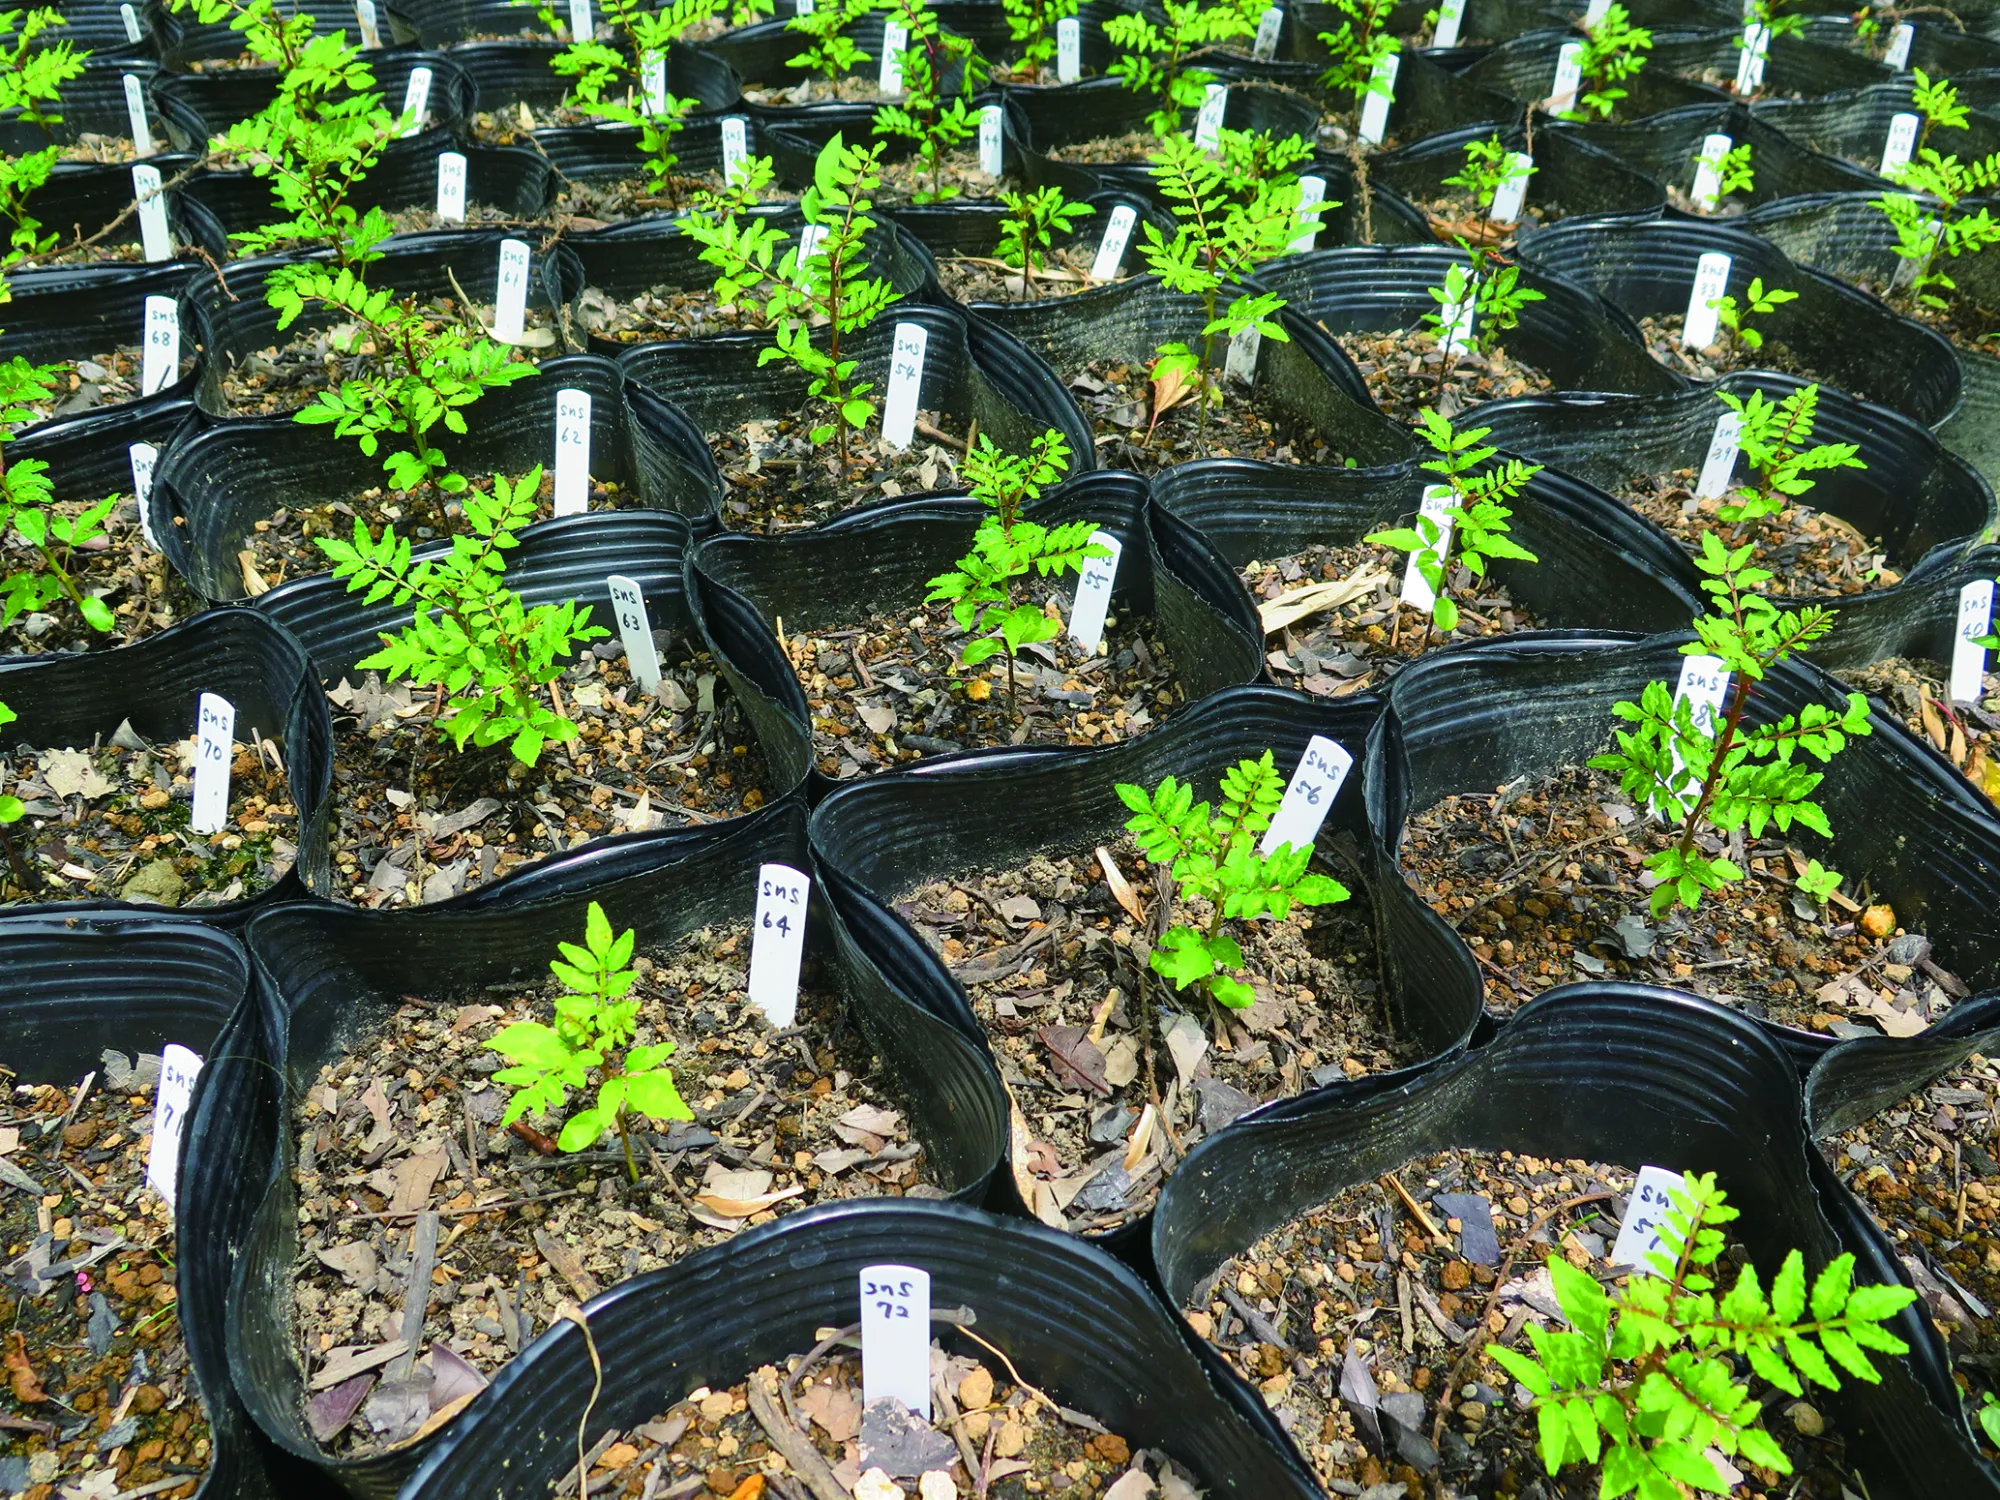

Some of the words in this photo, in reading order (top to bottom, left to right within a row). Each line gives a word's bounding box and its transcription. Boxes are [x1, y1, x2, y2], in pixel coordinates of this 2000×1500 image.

[443, 186, 457, 198] 60
[150, 331, 174, 348] 68
[894, 361, 917, 382] 54
[560, 426, 583, 446] 62
[623, 612, 641, 632] 63
[1961, 621, 1985, 641] 40
[203, 736, 222, 762] 70
[1295, 779, 1323, 805] 56
[762, 911, 792, 940] 64
[875, 1302, 911, 1320] 72
